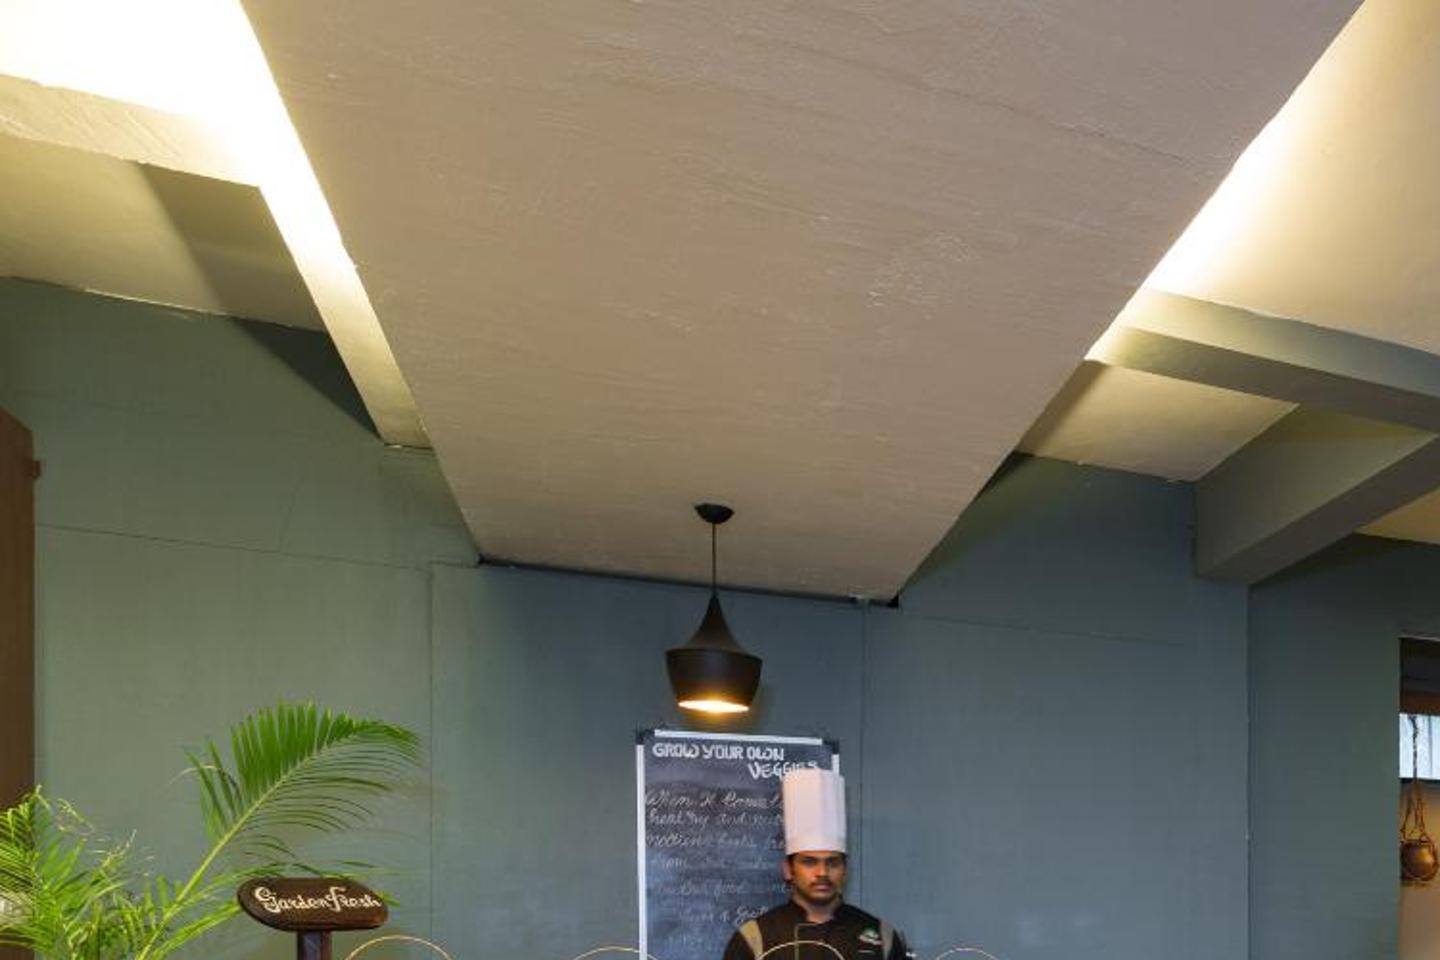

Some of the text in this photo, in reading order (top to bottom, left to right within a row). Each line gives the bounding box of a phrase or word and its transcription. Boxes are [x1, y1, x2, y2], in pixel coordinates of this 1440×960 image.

[652, 743, 784, 761] GROW YOUR OWN
